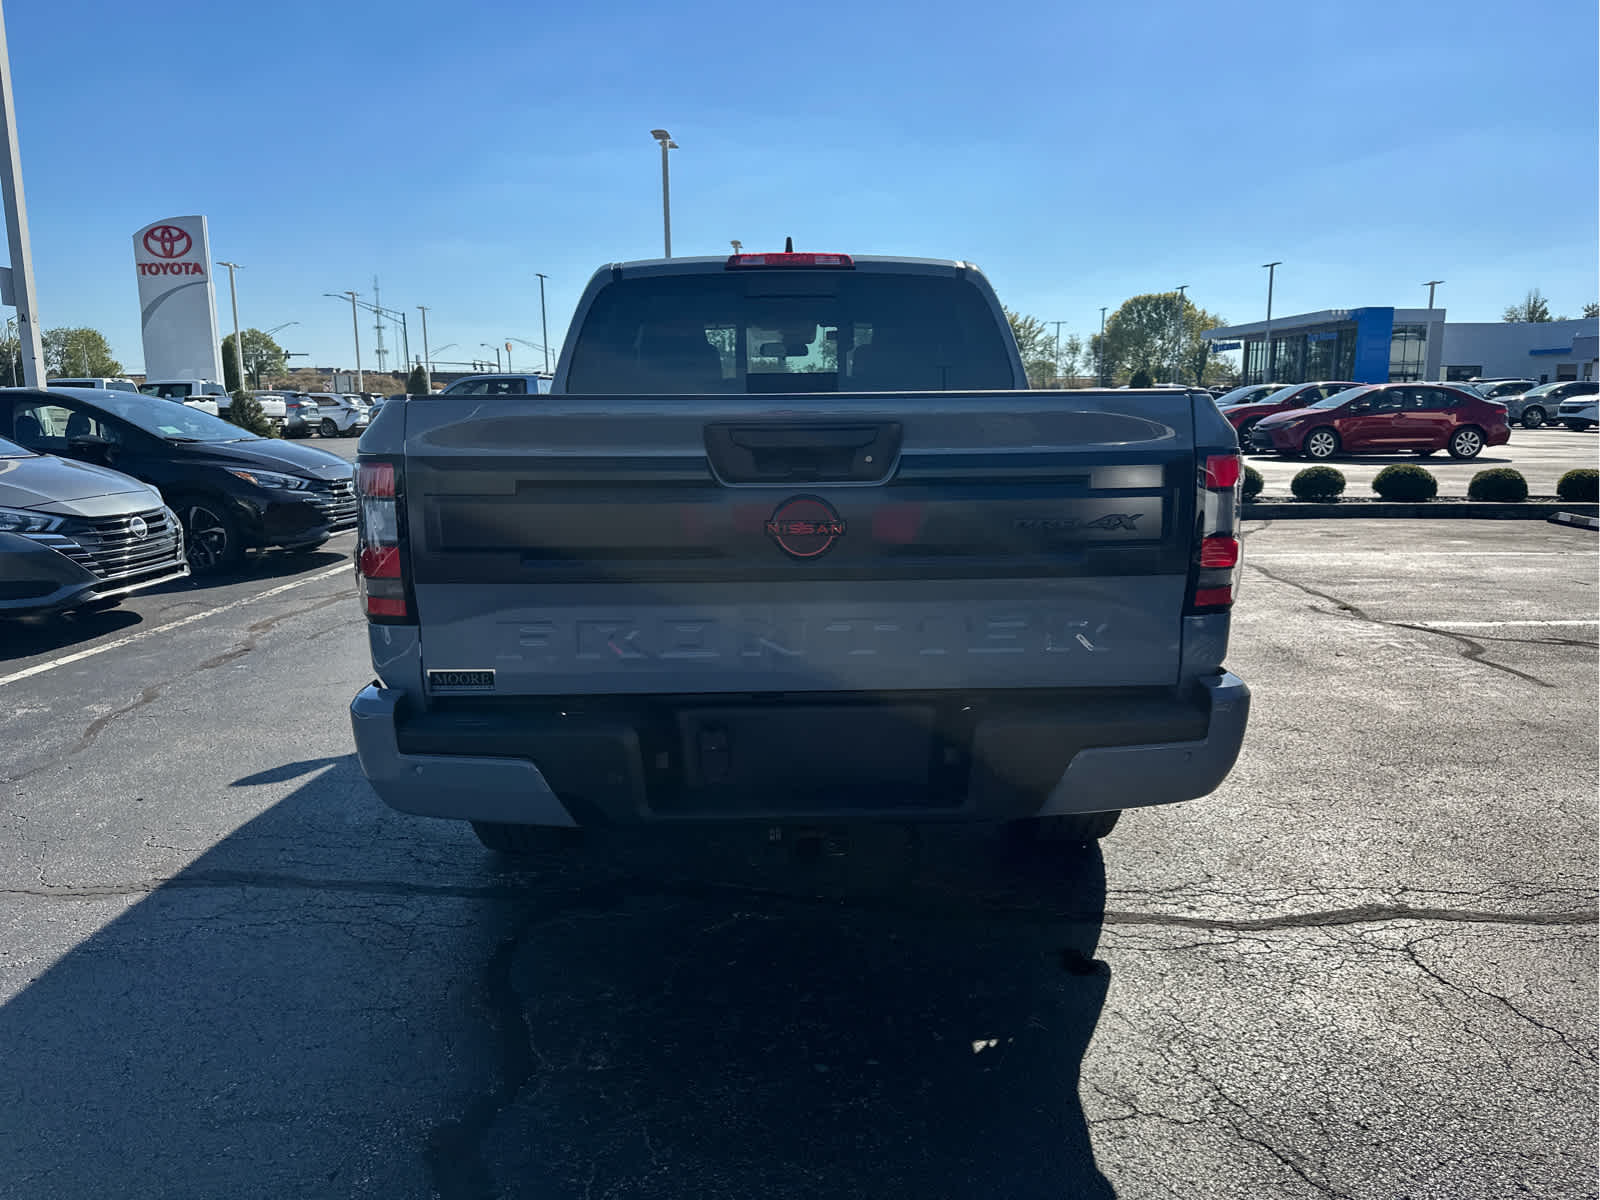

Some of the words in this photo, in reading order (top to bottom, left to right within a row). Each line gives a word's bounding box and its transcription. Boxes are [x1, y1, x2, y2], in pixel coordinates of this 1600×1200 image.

[138, 262, 204, 276] TOYOTA
[766, 519, 844, 535] NISSAN
[498, 618, 1111, 660] FRONTIER
[432, 672, 493, 685] MOORE
